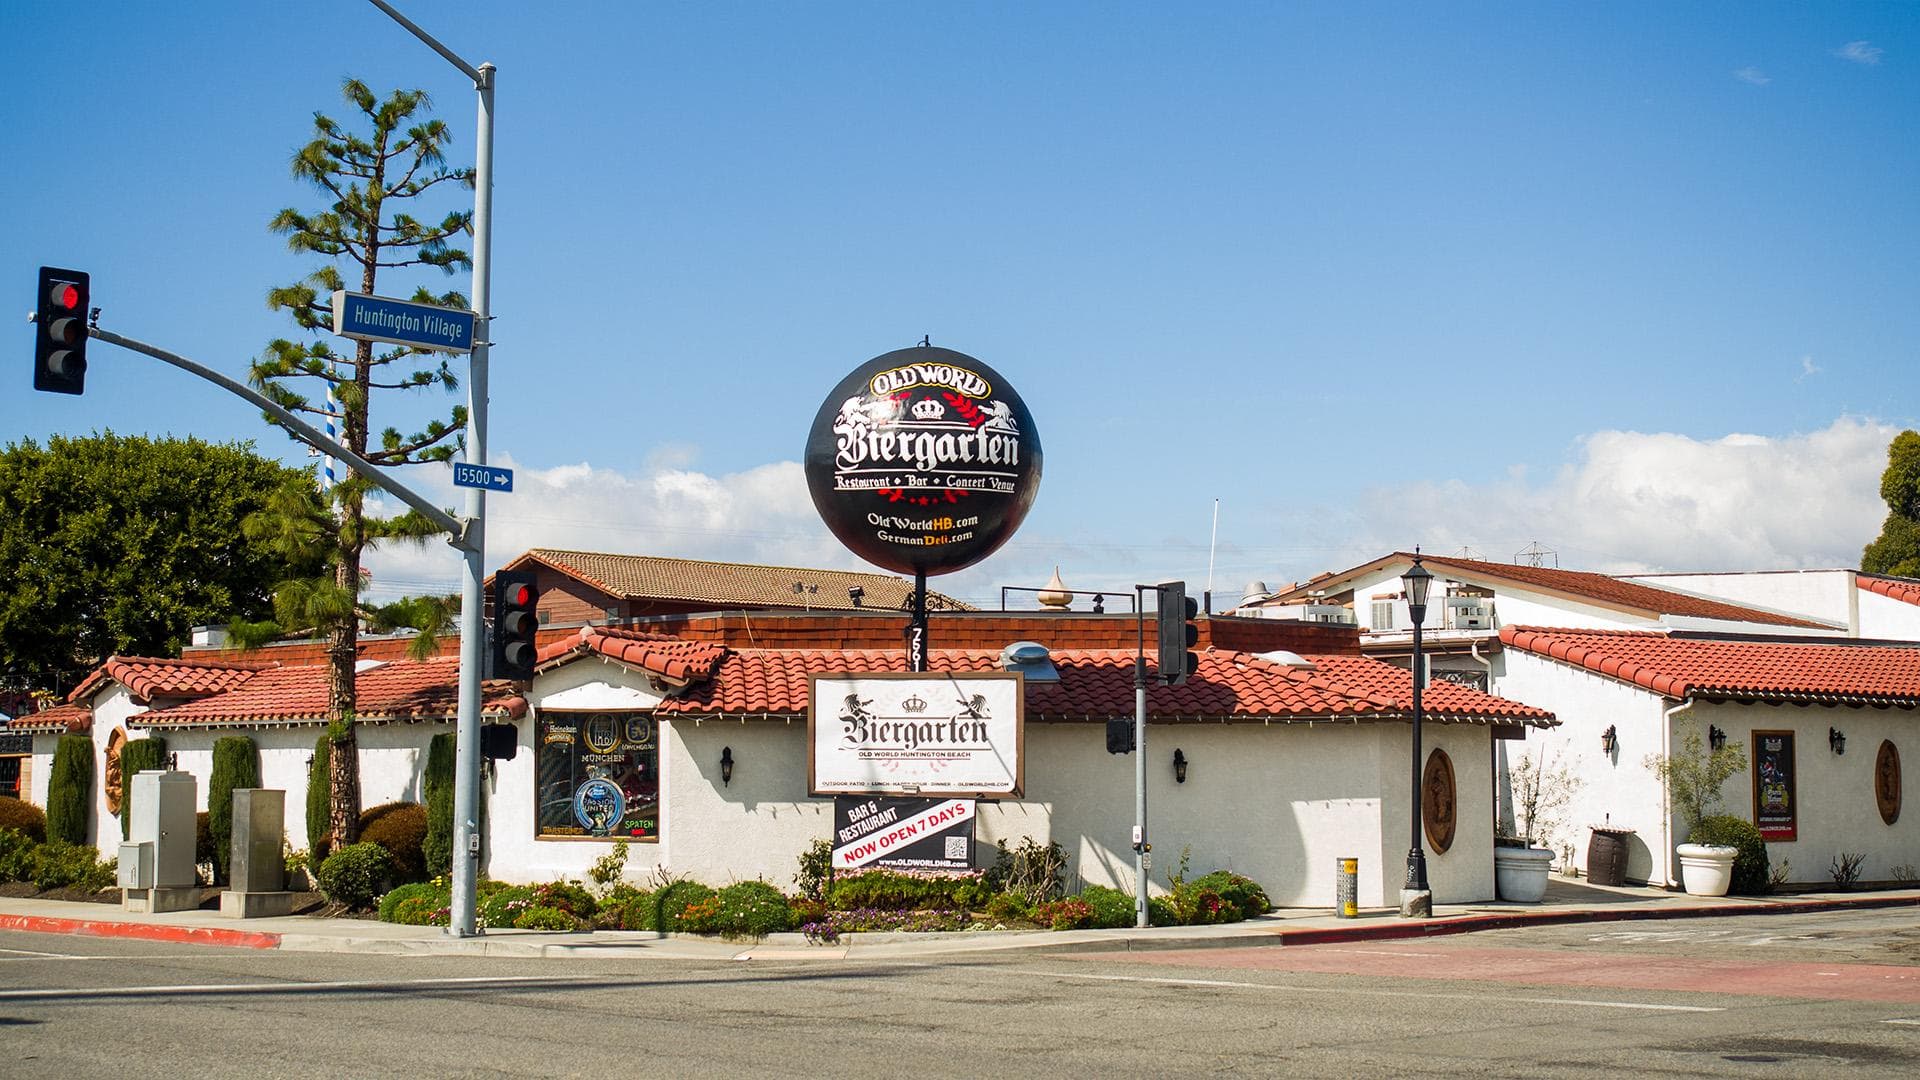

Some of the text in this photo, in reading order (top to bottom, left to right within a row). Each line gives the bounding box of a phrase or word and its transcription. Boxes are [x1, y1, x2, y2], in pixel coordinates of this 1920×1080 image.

[355, 304, 462, 343] Huntington Village
[872, 365, 987, 396] OLD WORLD
[833, 421, 1020, 472] Biergarten
[457, 467, 490, 485] 15500
[834, 474, 1015, 491] Restaurant Bar Concert Venue
[877, 530, 973, 546] GermanDeli.com
[912, 628, 922, 672] 7561
[838, 714, 989, 750] Biergarten
[624, 820, 654, 829] SPATEN
[838, 807, 898, 843] RESTAURANT
[848, 800, 878, 821] BAR &
[843, 803, 966, 864] NOW OPEN 7 DAYS
[878, 859, 968, 868] www.OLDWORLDHB.com
